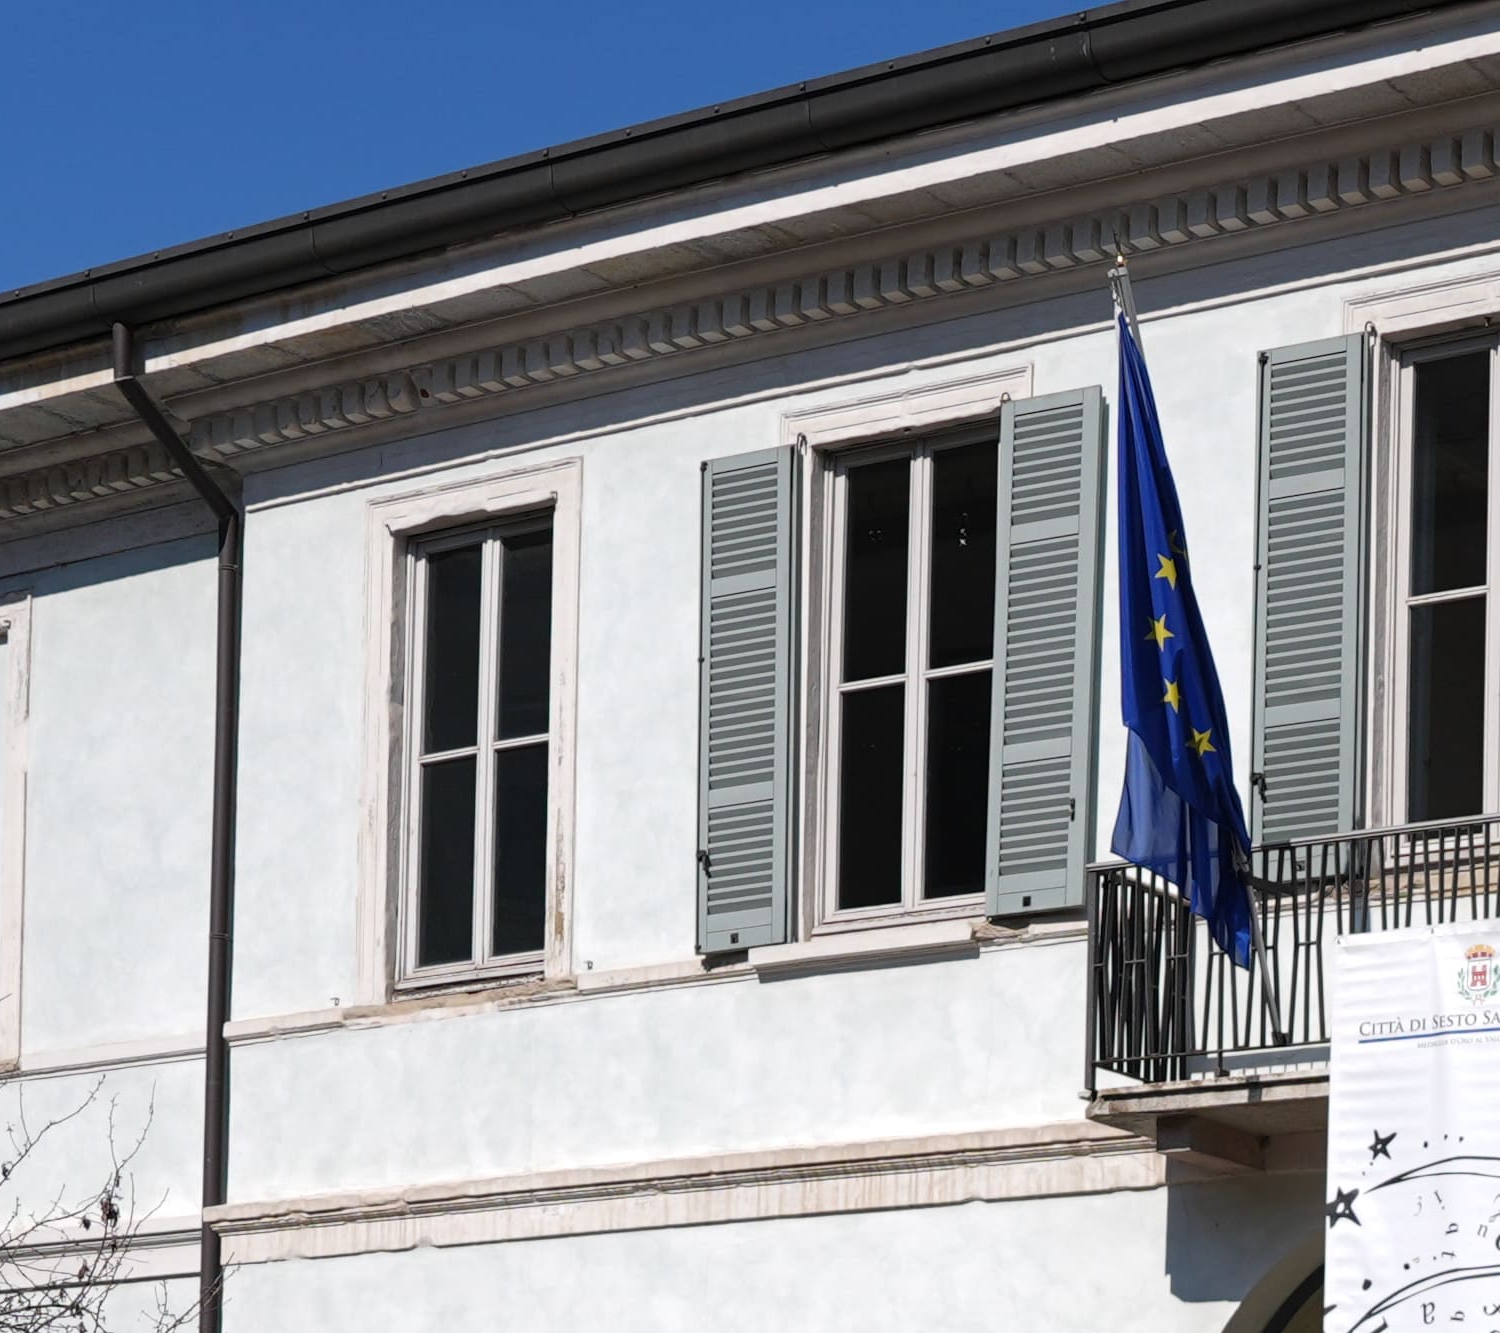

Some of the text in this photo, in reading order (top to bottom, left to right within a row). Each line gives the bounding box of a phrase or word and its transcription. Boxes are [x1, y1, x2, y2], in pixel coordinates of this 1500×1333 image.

[1359, 1016, 1403, 1037] CITTÀ
[1410, 1018, 1426, 1032] DI
[1432, 1013, 1477, 1030] SESTO
